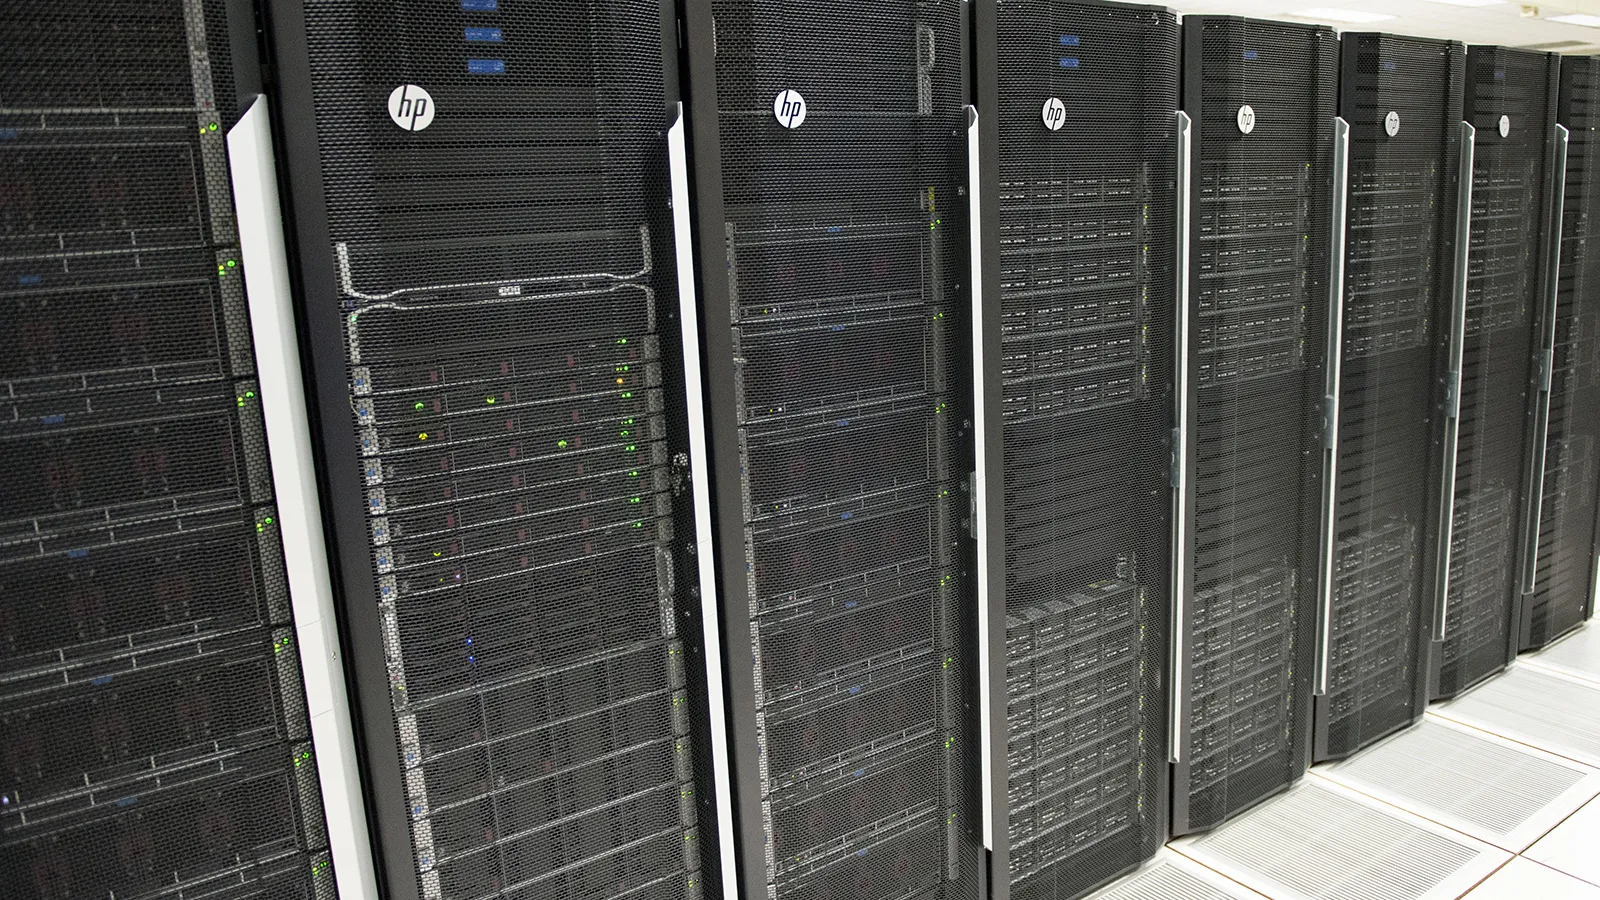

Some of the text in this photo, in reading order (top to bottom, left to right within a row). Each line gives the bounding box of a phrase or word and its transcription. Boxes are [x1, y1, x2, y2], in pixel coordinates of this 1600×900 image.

[397, 84, 428, 131] hp
[779, 89, 802, 129] hp
[1046, 97, 1063, 131] hp
[1240, 105, 1253, 134] hp
